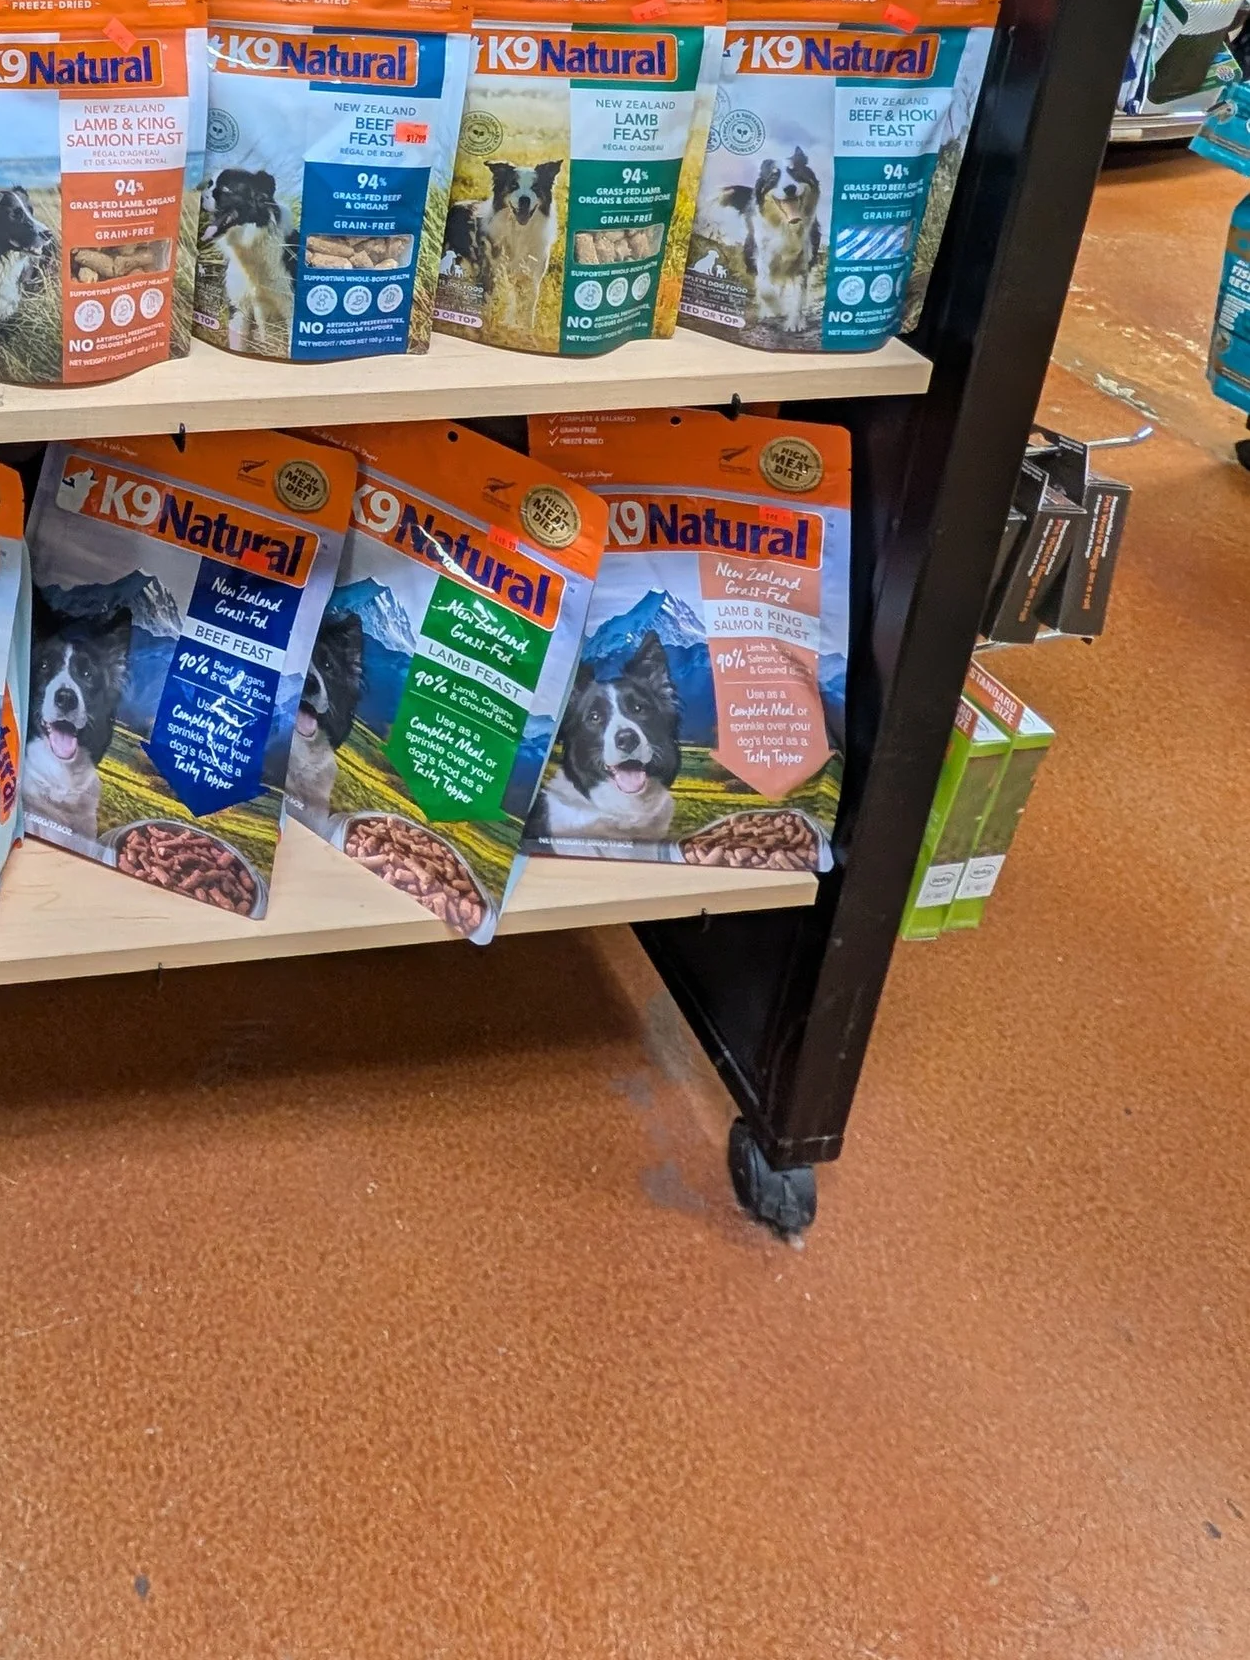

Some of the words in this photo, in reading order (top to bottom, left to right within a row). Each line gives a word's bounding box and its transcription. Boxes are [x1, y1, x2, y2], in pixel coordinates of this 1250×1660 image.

[12, 0, 92, 10] FREEZE-DRIED
[615, 113, 658, 125] LAMB
[849, 109, 882, 121] BEEF
[885, 110, 895, 121] &
[900, 109, 938, 121] HOKI
[74, 118, 117, 132] LAMB
[123, 118, 133, 131] &
[137, 117, 176, 131] KING
[355, 118, 394, 130] BEEF
[869, 124, 915, 137] FEAST
[66, 133, 133, 148] SALMON
[138, 132, 183, 147] FEAST
[349, 132, 396, 146] FEAST
[613, 128, 659, 140] FEAST
[357, 173, 387, 188] 94%
[622, 167, 649, 184] 94%
[781, 447, 809, 462] HIGH
[770, 453, 811, 473] MEAT
[773, 466, 802, 481] DIET
[214, 601, 268, 630] Grass-Fed
[717, 606, 749, 617] LAMB
[754, 608, 763, 618] &
[767, 610, 802, 628] KING
[714, 620, 763, 631] SALMON
[767, 622, 810, 641] FEAST
[194, 625, 229, 644] BEEF
[232, 638, 273, 663] FEAST
[427, 643, 471, 672] LAMB
[474, 664, 521, 699] FEAST
[414, 670, 448, 695] 90%
[968, 666, 1018, 714] STANDARD
[992, 701, 1016, 725] SIZE
